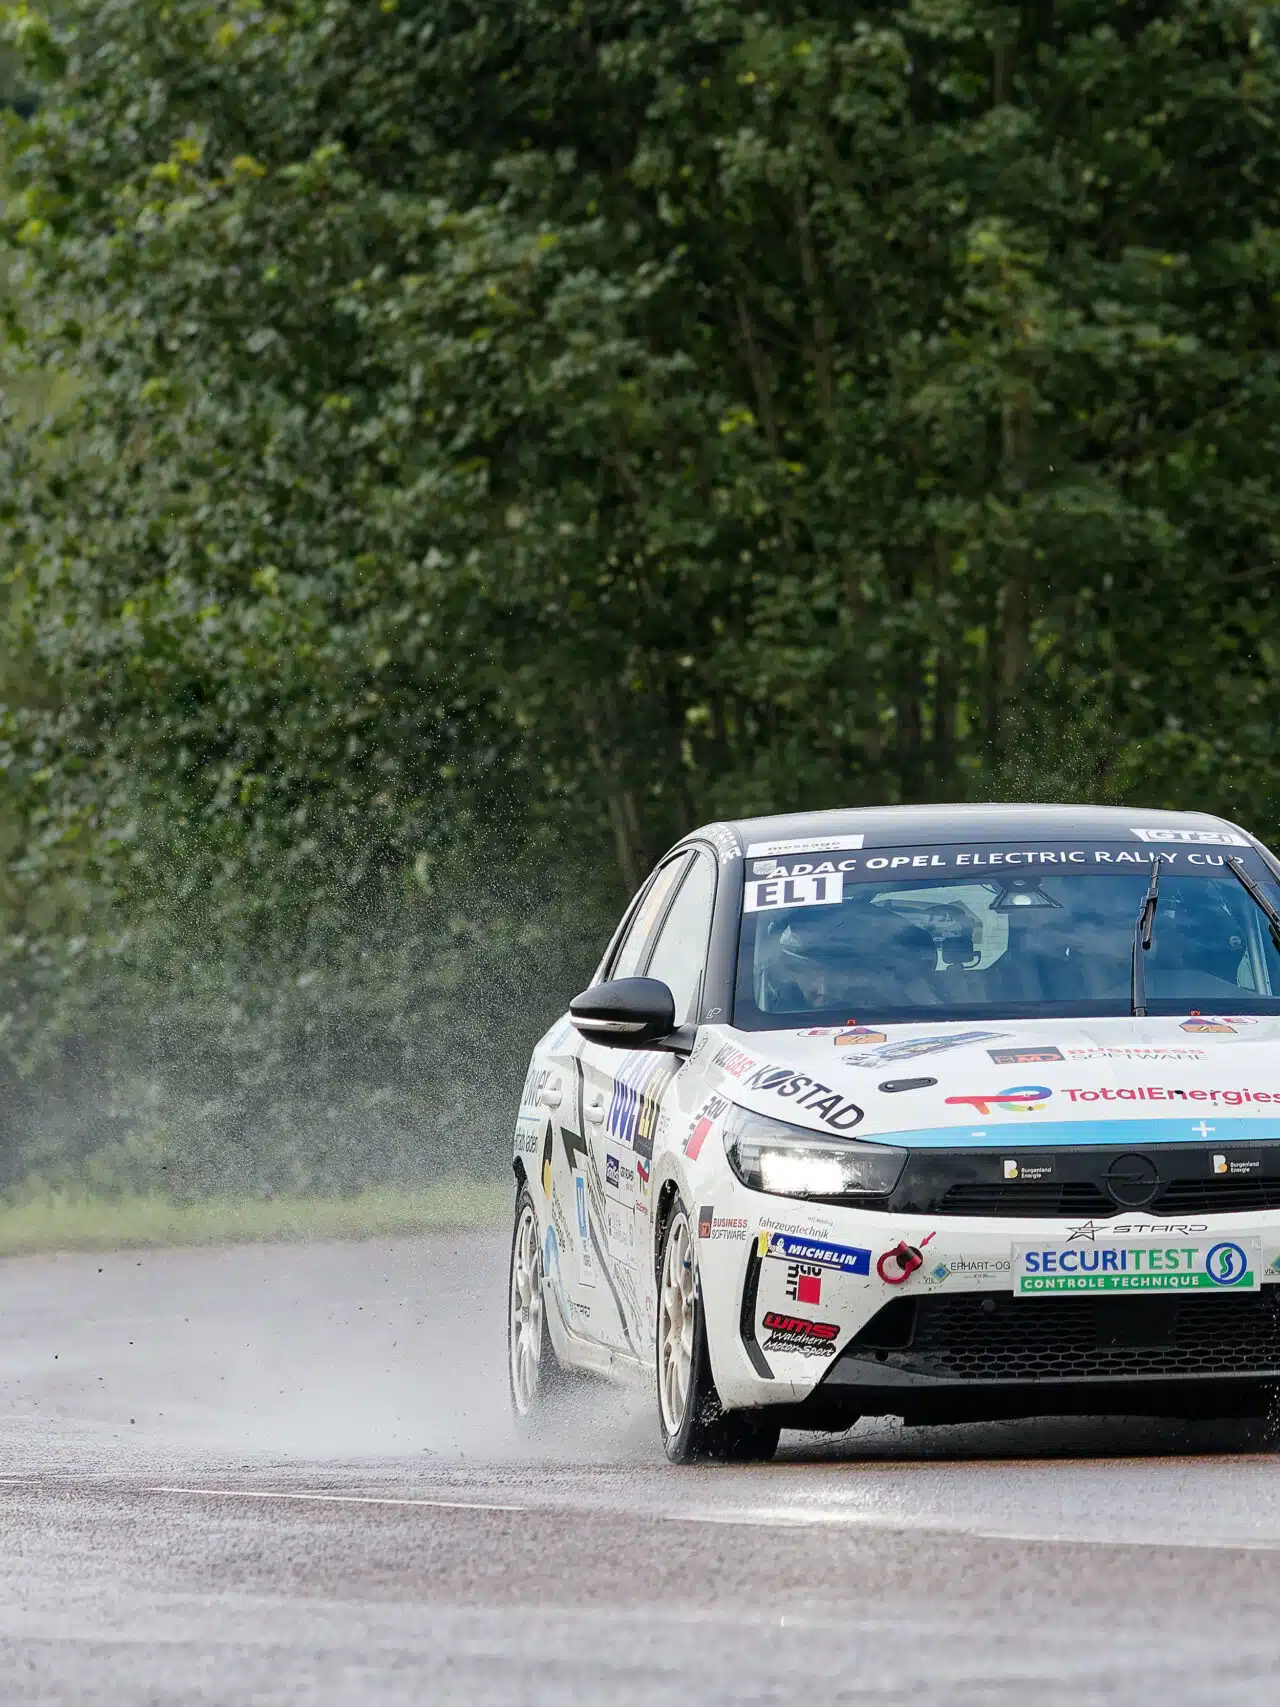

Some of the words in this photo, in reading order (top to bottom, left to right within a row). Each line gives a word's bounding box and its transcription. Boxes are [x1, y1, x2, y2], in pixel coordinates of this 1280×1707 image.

[766, 859, 857, 879] ADAC
[865, 854, 946, 870] OPEL
[956, 851, 1086, 866] ELECTRIC
[1095, 851, 1178, 865] RALLY
[756, 876, 827, 908] EL1
[1072, 1053, 1209, 1062] SOFTWARE
[743, 1064, 865, 1130] KOSTAD
[1021, 1166, 1052, 1174] Burgenland
[712, 1218, 748, 1229] BUSINESS
[758, 1216, 830, 1240] fahrzeugtechnik
[1113, 1224, 1208, 1235] STARD
[711, 1229, 747, 1241] SOFTWARE
[787, 1244, 858, 1266] MICHELIN
[1025, 1248, 1199, 1273] SECURITEST
[950, 1261, 1011, 1271] ERHART-OG
[1024, 1277, 1104, 1289] CONTROLE
[1112, 1276, 1200, 1288] TECHNIQUE
[773, 1331, 827, 1345] Waldherr
